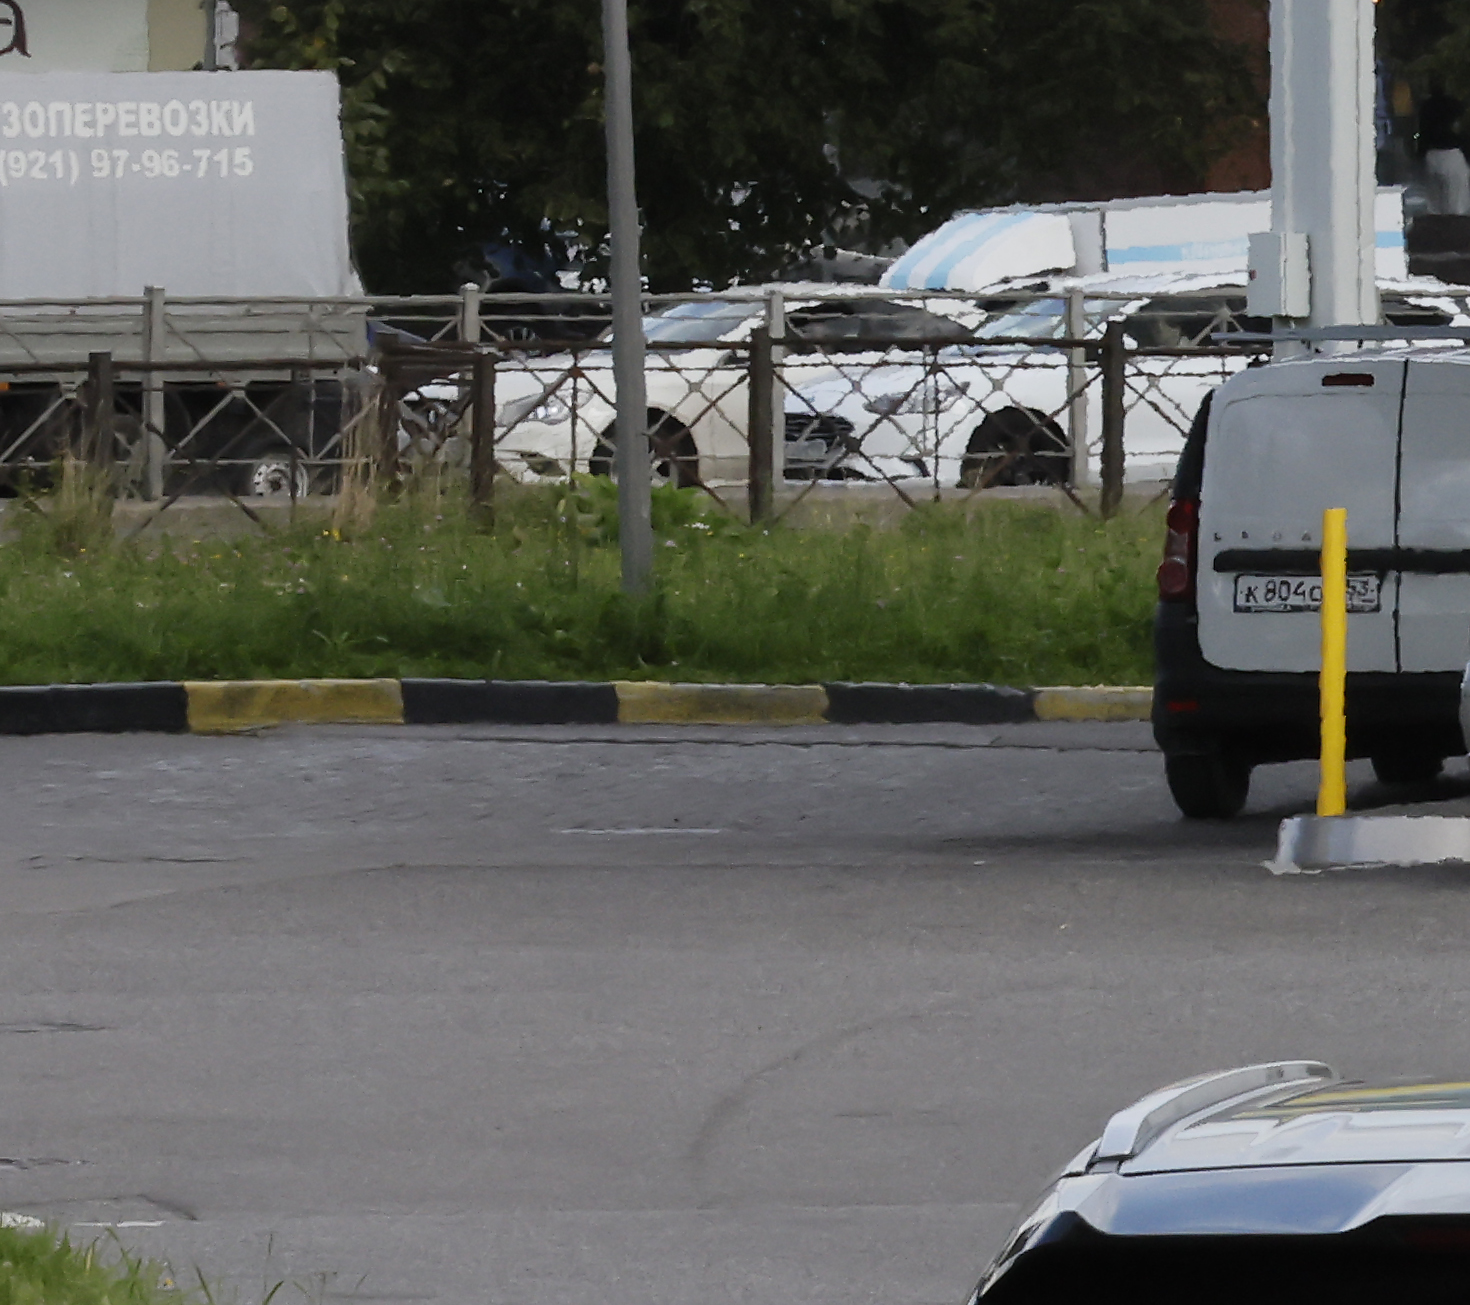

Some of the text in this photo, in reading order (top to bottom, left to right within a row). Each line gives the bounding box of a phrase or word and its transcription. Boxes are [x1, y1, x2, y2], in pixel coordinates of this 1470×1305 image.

[2, 99, 255, 138] ЗОПЕРЕВОЗКИ
[91, 146, 254, 179] 97-96-715
[1245, 579, 1324, 603] К804С
